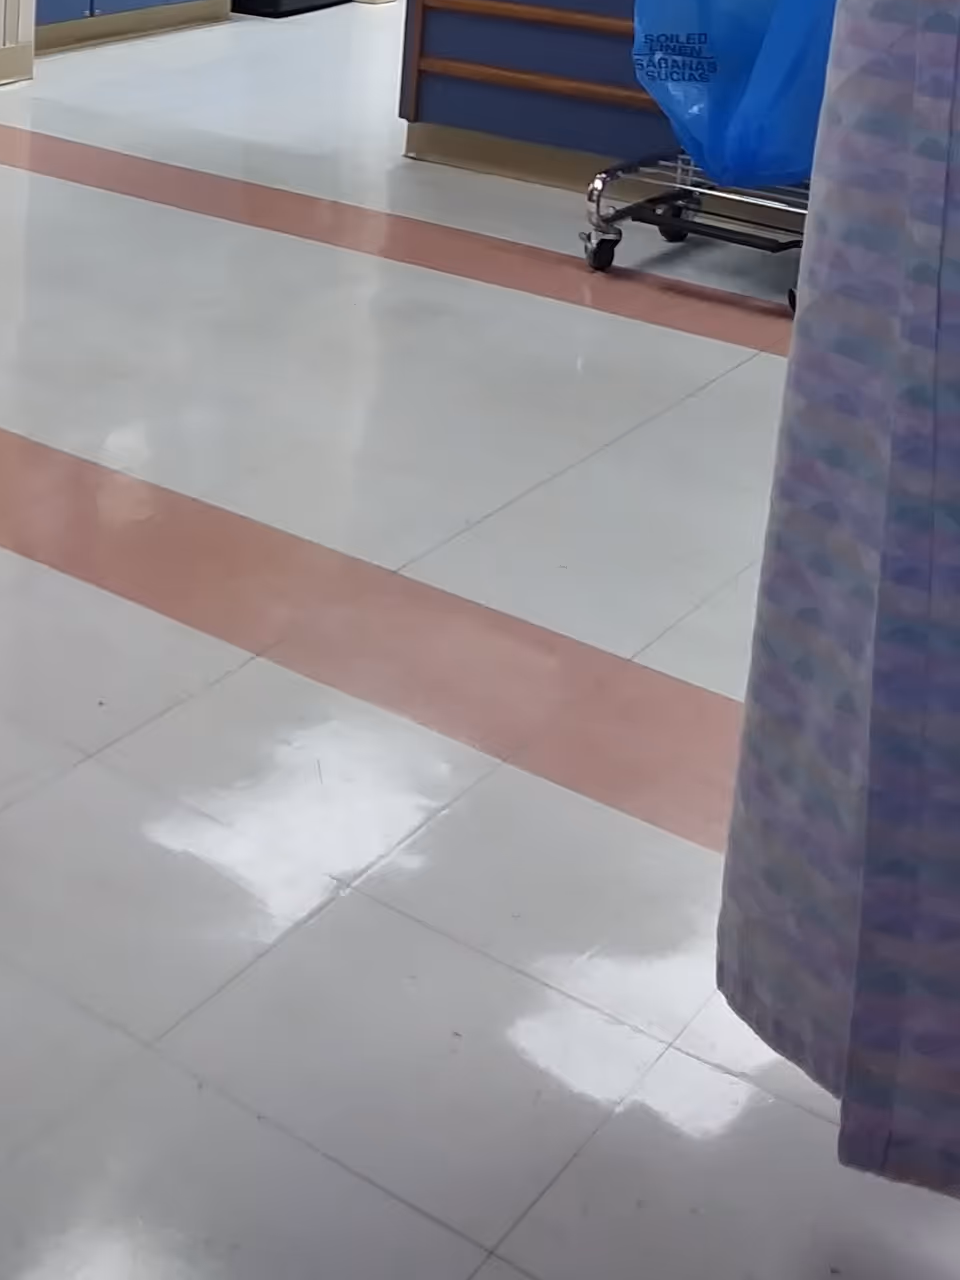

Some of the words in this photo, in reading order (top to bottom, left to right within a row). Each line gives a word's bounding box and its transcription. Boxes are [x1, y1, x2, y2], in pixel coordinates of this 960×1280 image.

[644, 33, 707, 45] SOILED
[649, 43, 703, 57] LINEN
[647, 70, 710, 83] SUCIAS
